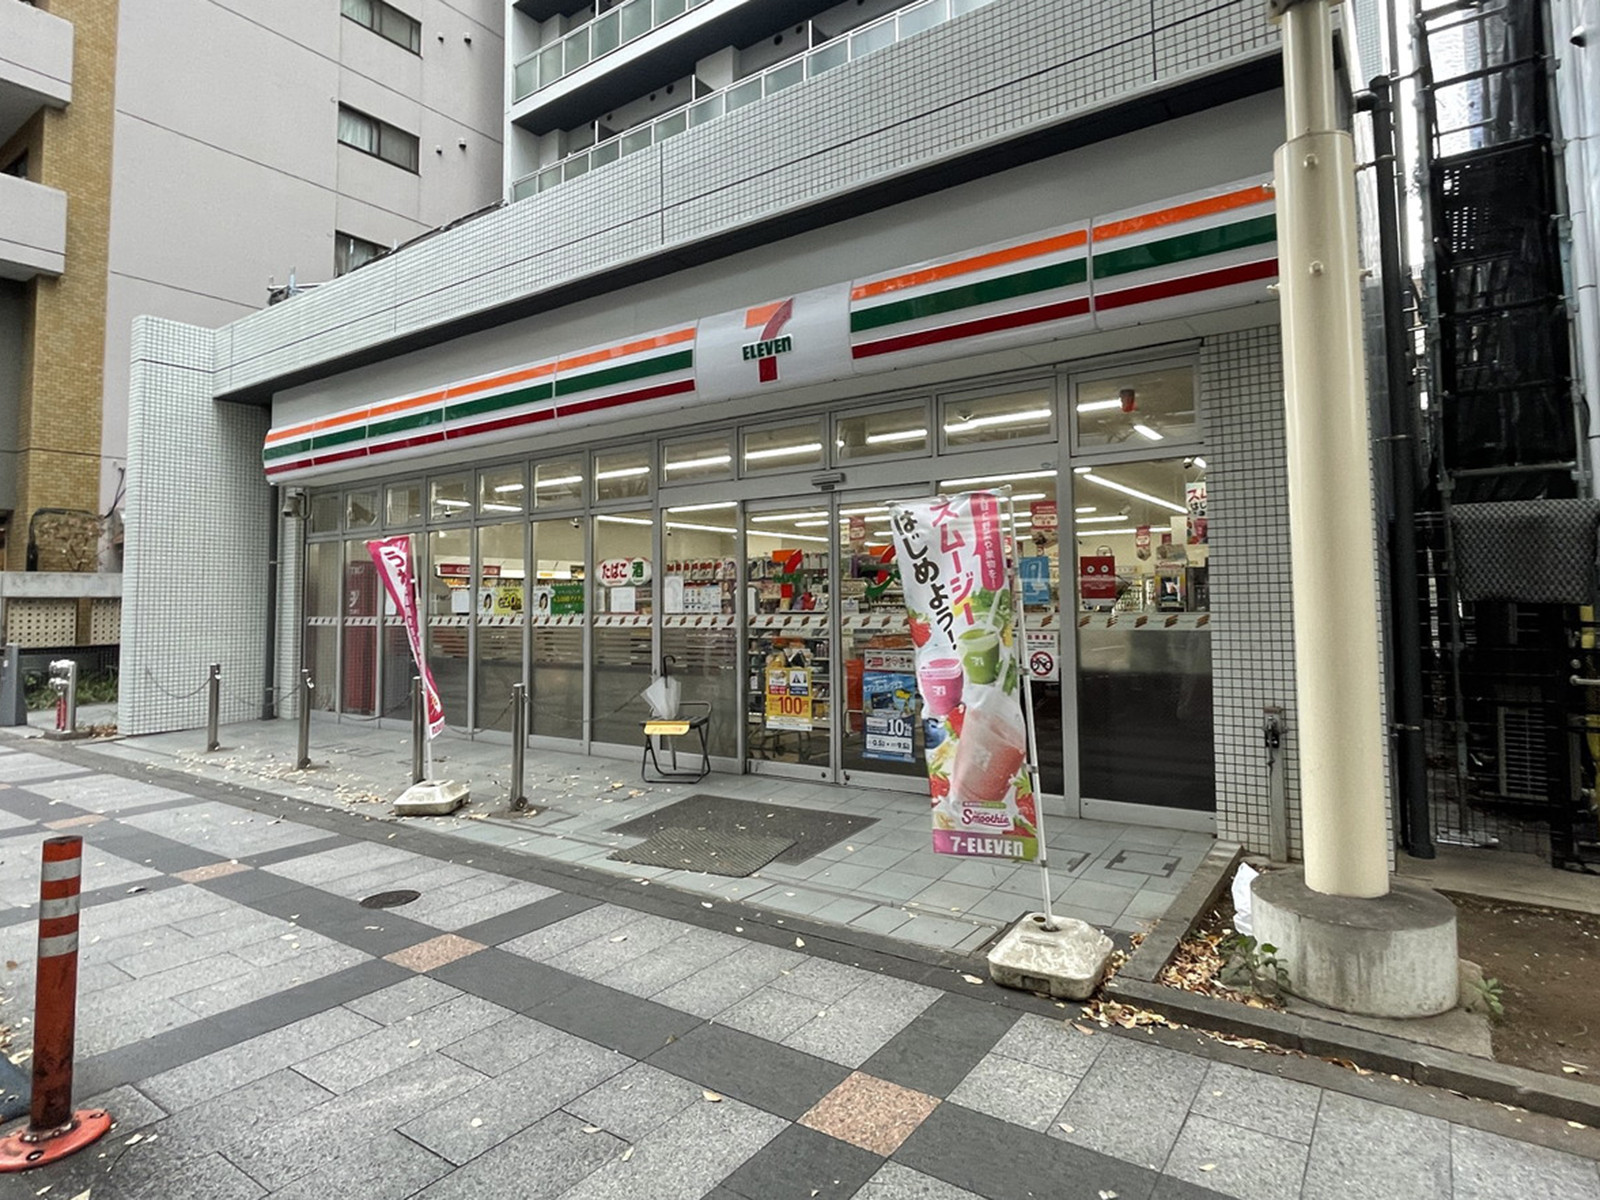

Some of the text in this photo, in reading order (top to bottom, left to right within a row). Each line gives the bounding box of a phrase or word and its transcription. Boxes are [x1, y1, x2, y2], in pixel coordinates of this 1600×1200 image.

[745, 298, 794, 383] 7
[601, 561, 645, 580] たばこ 酒
[929, 502, 975, 626] スムージー
[778, 696, 802, 715] 100
[962, 808, 1011, 827] Smoothie
